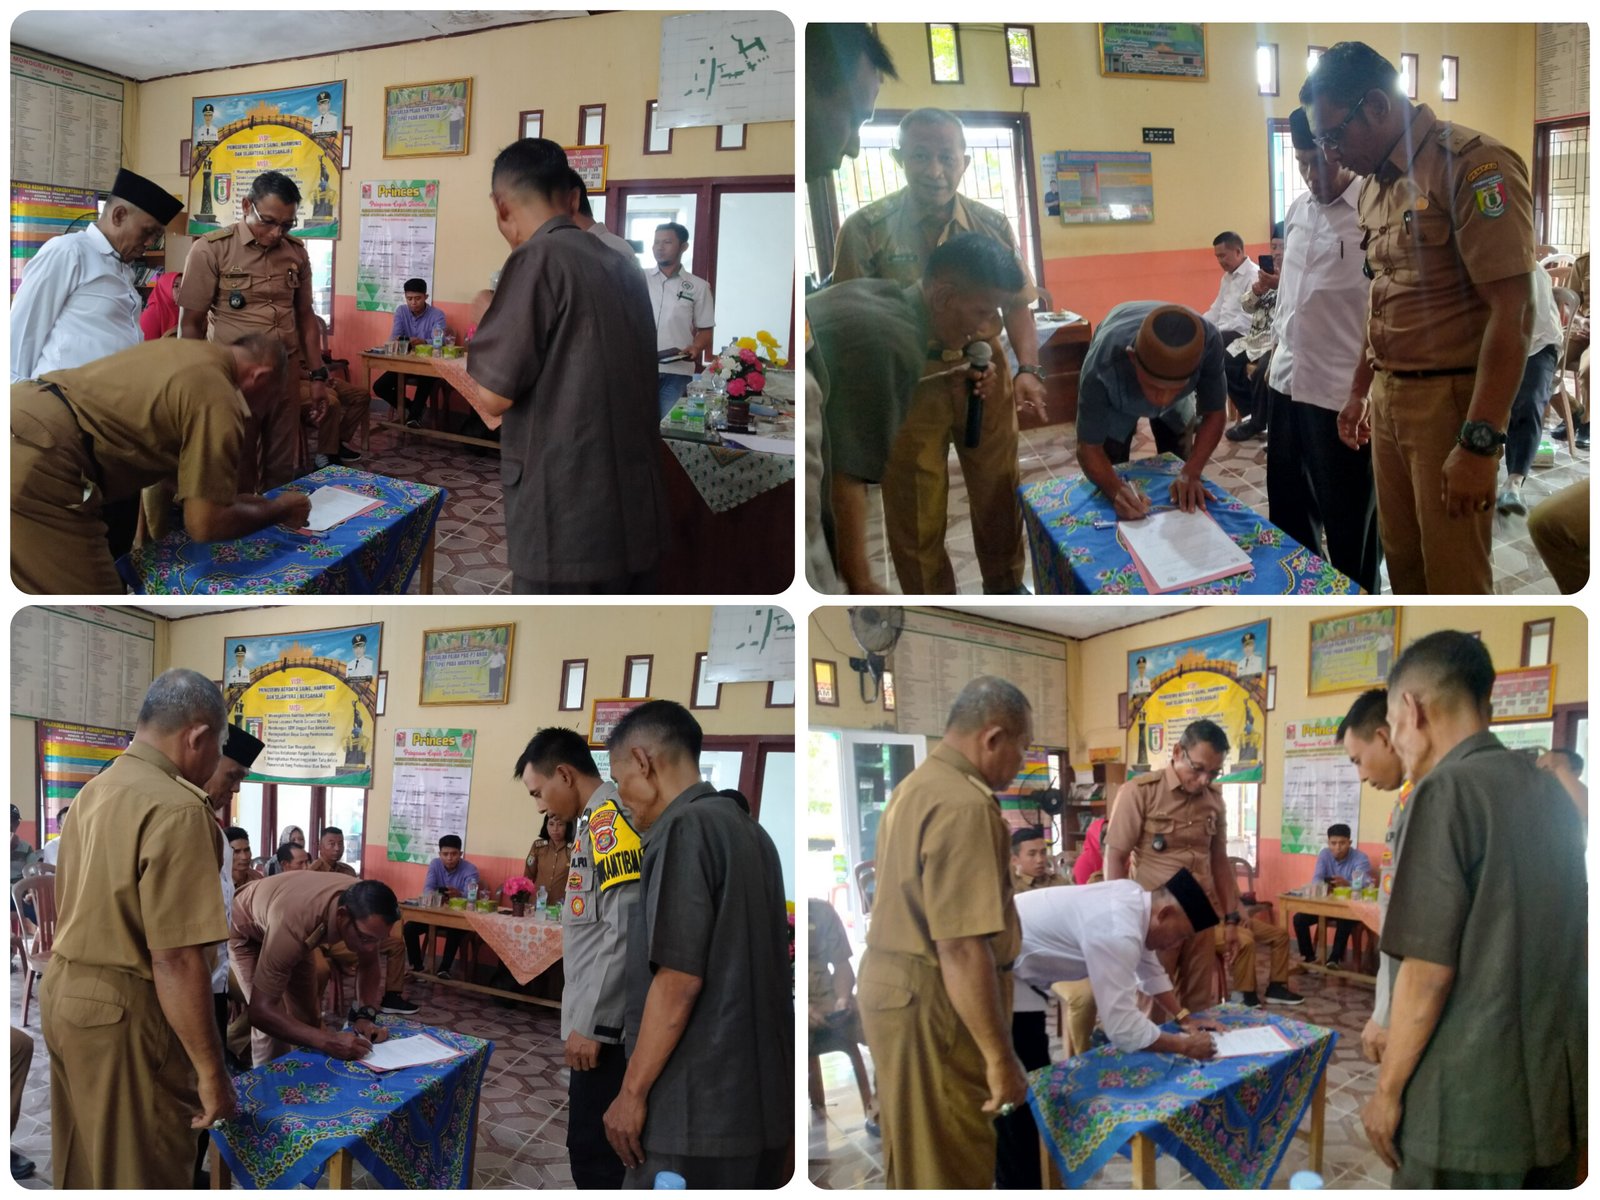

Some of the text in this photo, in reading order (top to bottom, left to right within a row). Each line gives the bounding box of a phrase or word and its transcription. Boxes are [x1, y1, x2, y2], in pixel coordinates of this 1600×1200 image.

[377, 184, 420, 198] Princes
[1302, 724, 1338, 738] Prince
[412, 732, 456, 747] Princes
